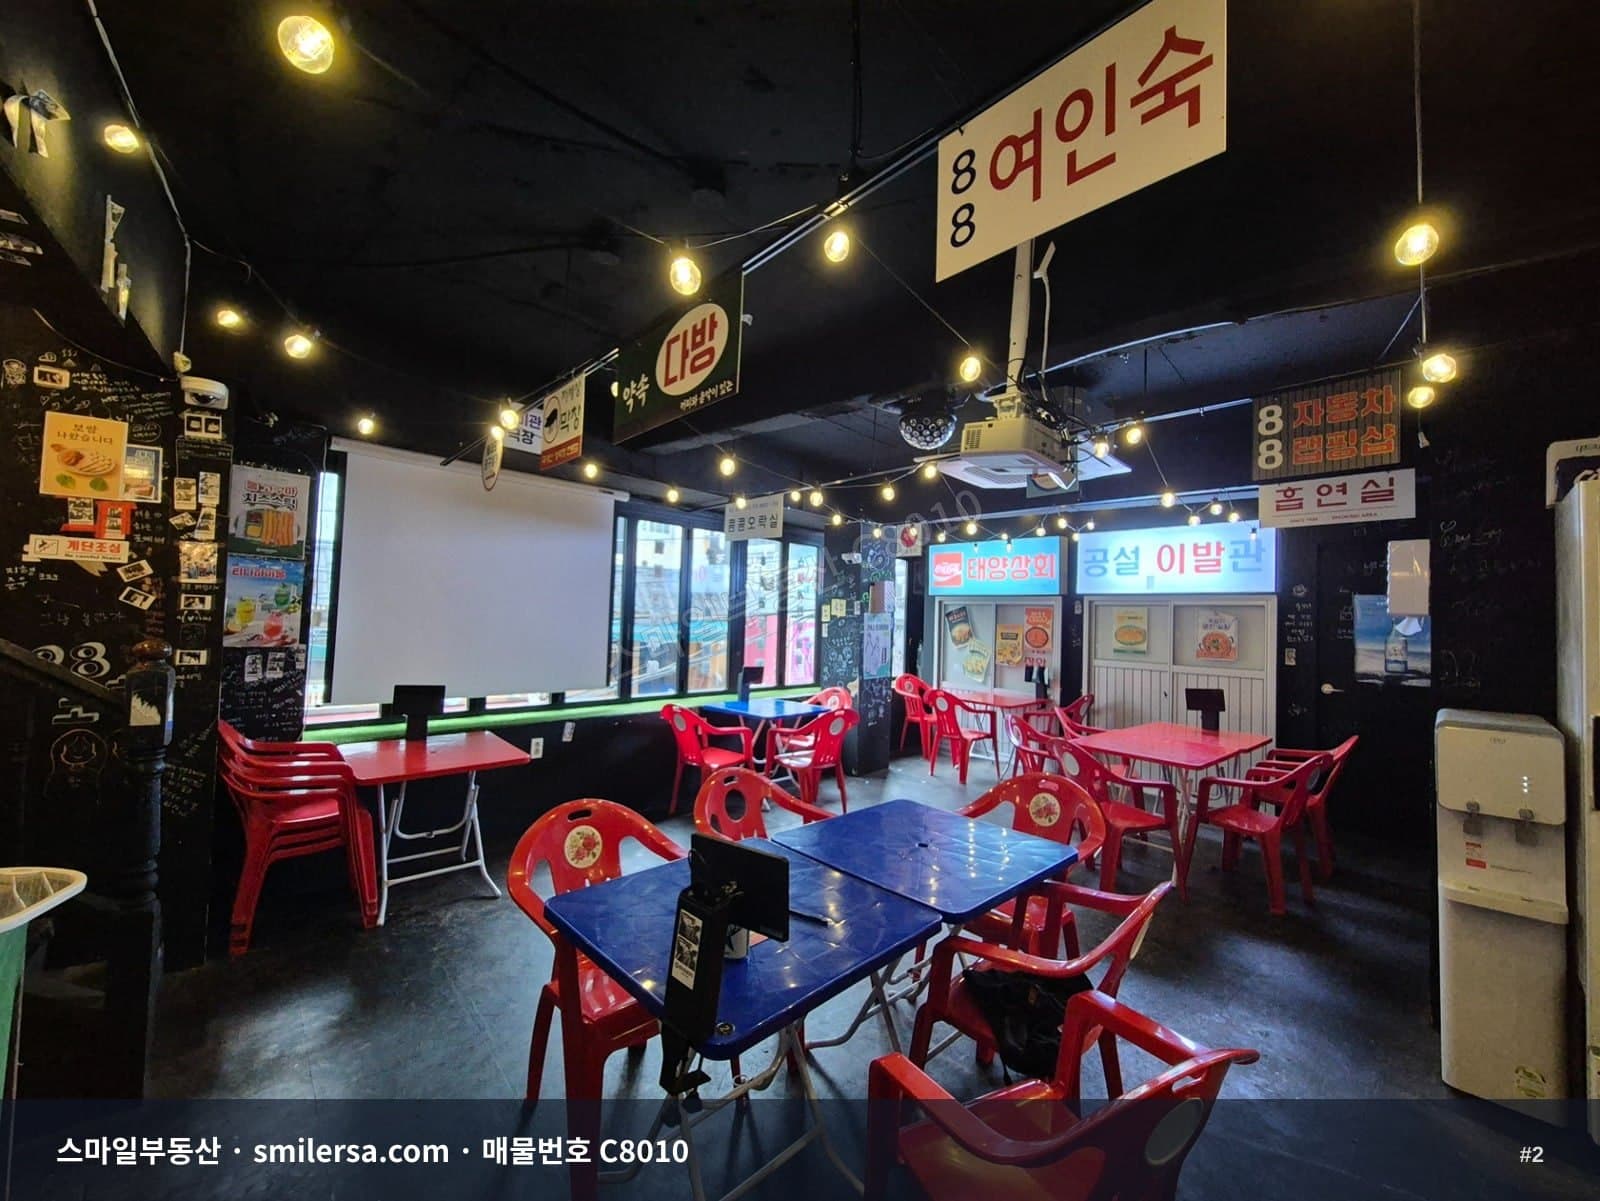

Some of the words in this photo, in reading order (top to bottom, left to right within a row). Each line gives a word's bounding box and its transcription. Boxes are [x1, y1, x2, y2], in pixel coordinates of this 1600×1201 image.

[989, 25, 1214, 202] 여인숙
[663, 311, 719, 388] 다방
[622, 373, 650, 413] 약속
[1292, 384, 1397, 429] 자동차
[1275, 477, 1395, 512] 흡연실
[66, 539, 122, 554] 계단조심
[1083, 546, 1141, 578] 공설
[966, 553, 1056, 580] 태양상회
